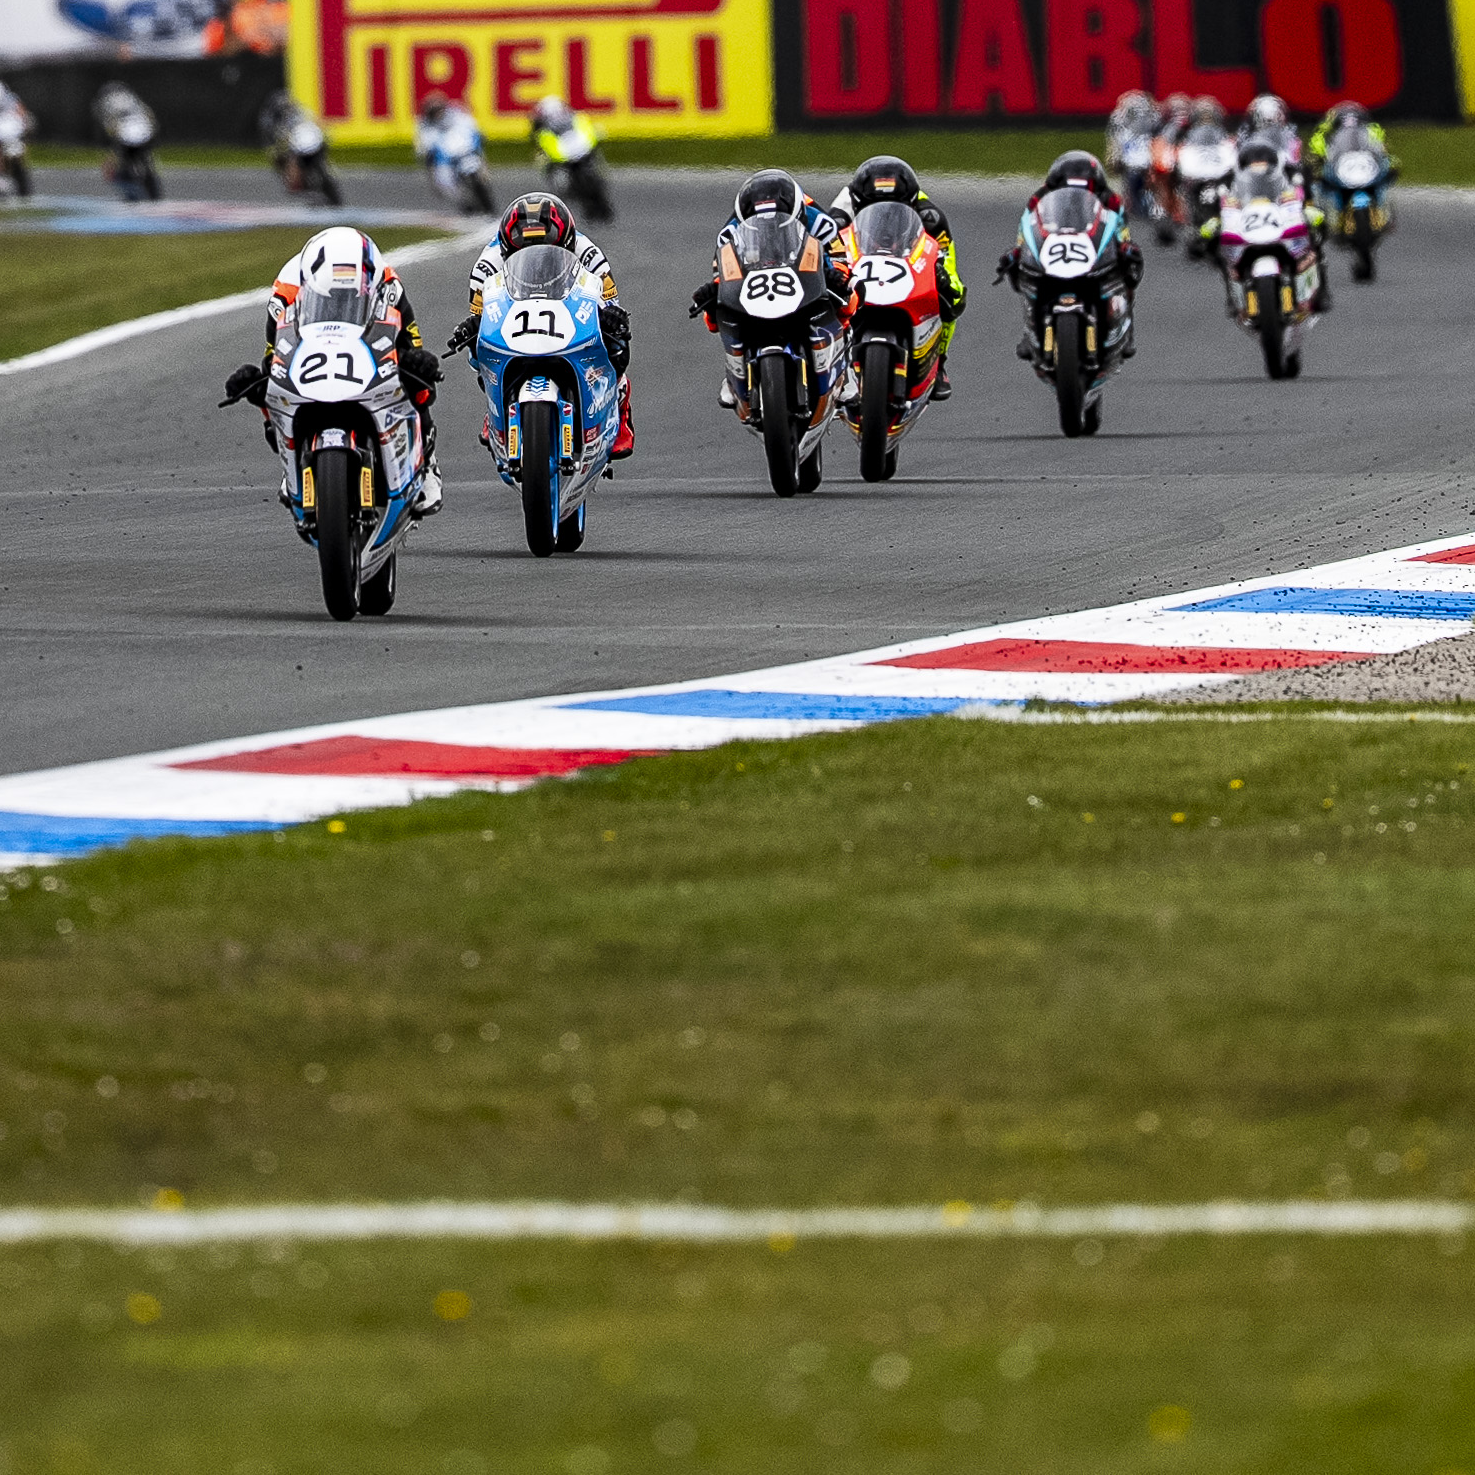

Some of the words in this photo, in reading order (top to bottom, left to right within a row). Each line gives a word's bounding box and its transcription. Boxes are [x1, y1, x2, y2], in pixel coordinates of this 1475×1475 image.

[1048, 242, 1089, 266] 95
[746, 271, 796, 300] 88
[858, 259, 908, 284] 17
[512, 310, 565, 340] 11
[299, 352, 364, 385] 21
